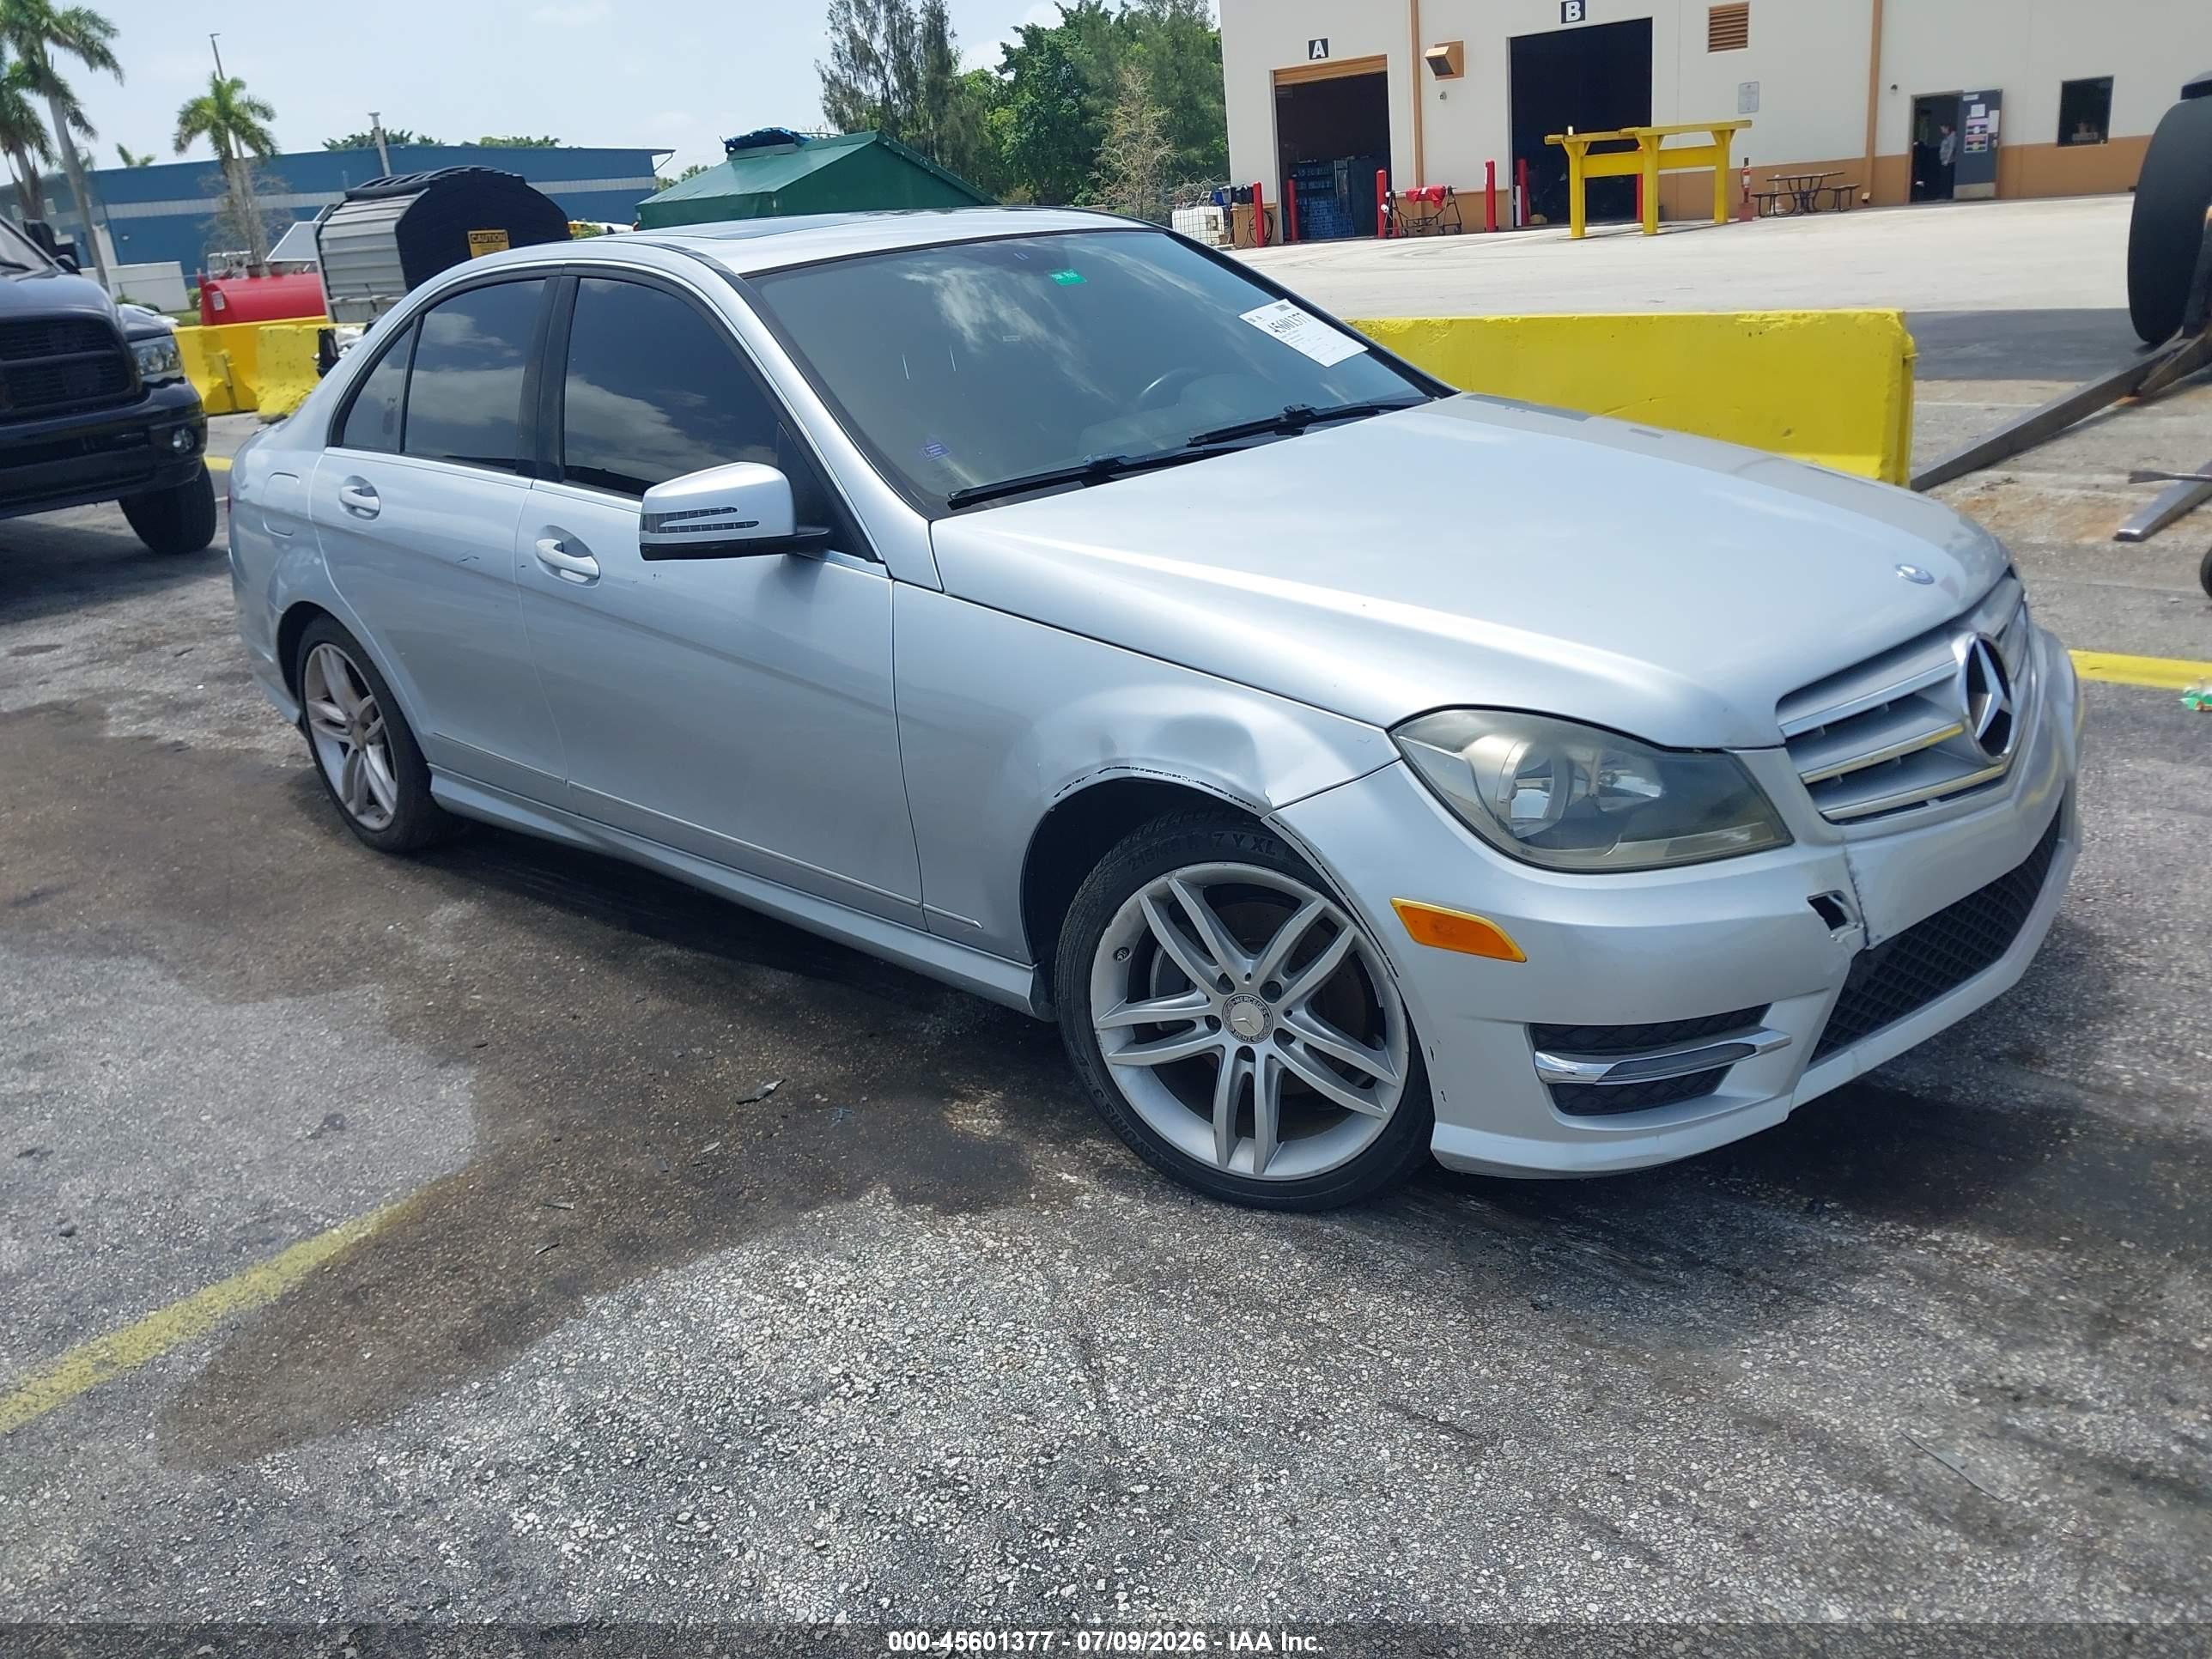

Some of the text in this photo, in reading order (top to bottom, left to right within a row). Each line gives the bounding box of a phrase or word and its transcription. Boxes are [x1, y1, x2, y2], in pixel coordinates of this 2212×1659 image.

[1565, 1, 1581, 22] B
[1311, 40, 1326, 58] A
[471, 233, 506, 243] CAUTION
[1250, 836, 1276, 855] XL
